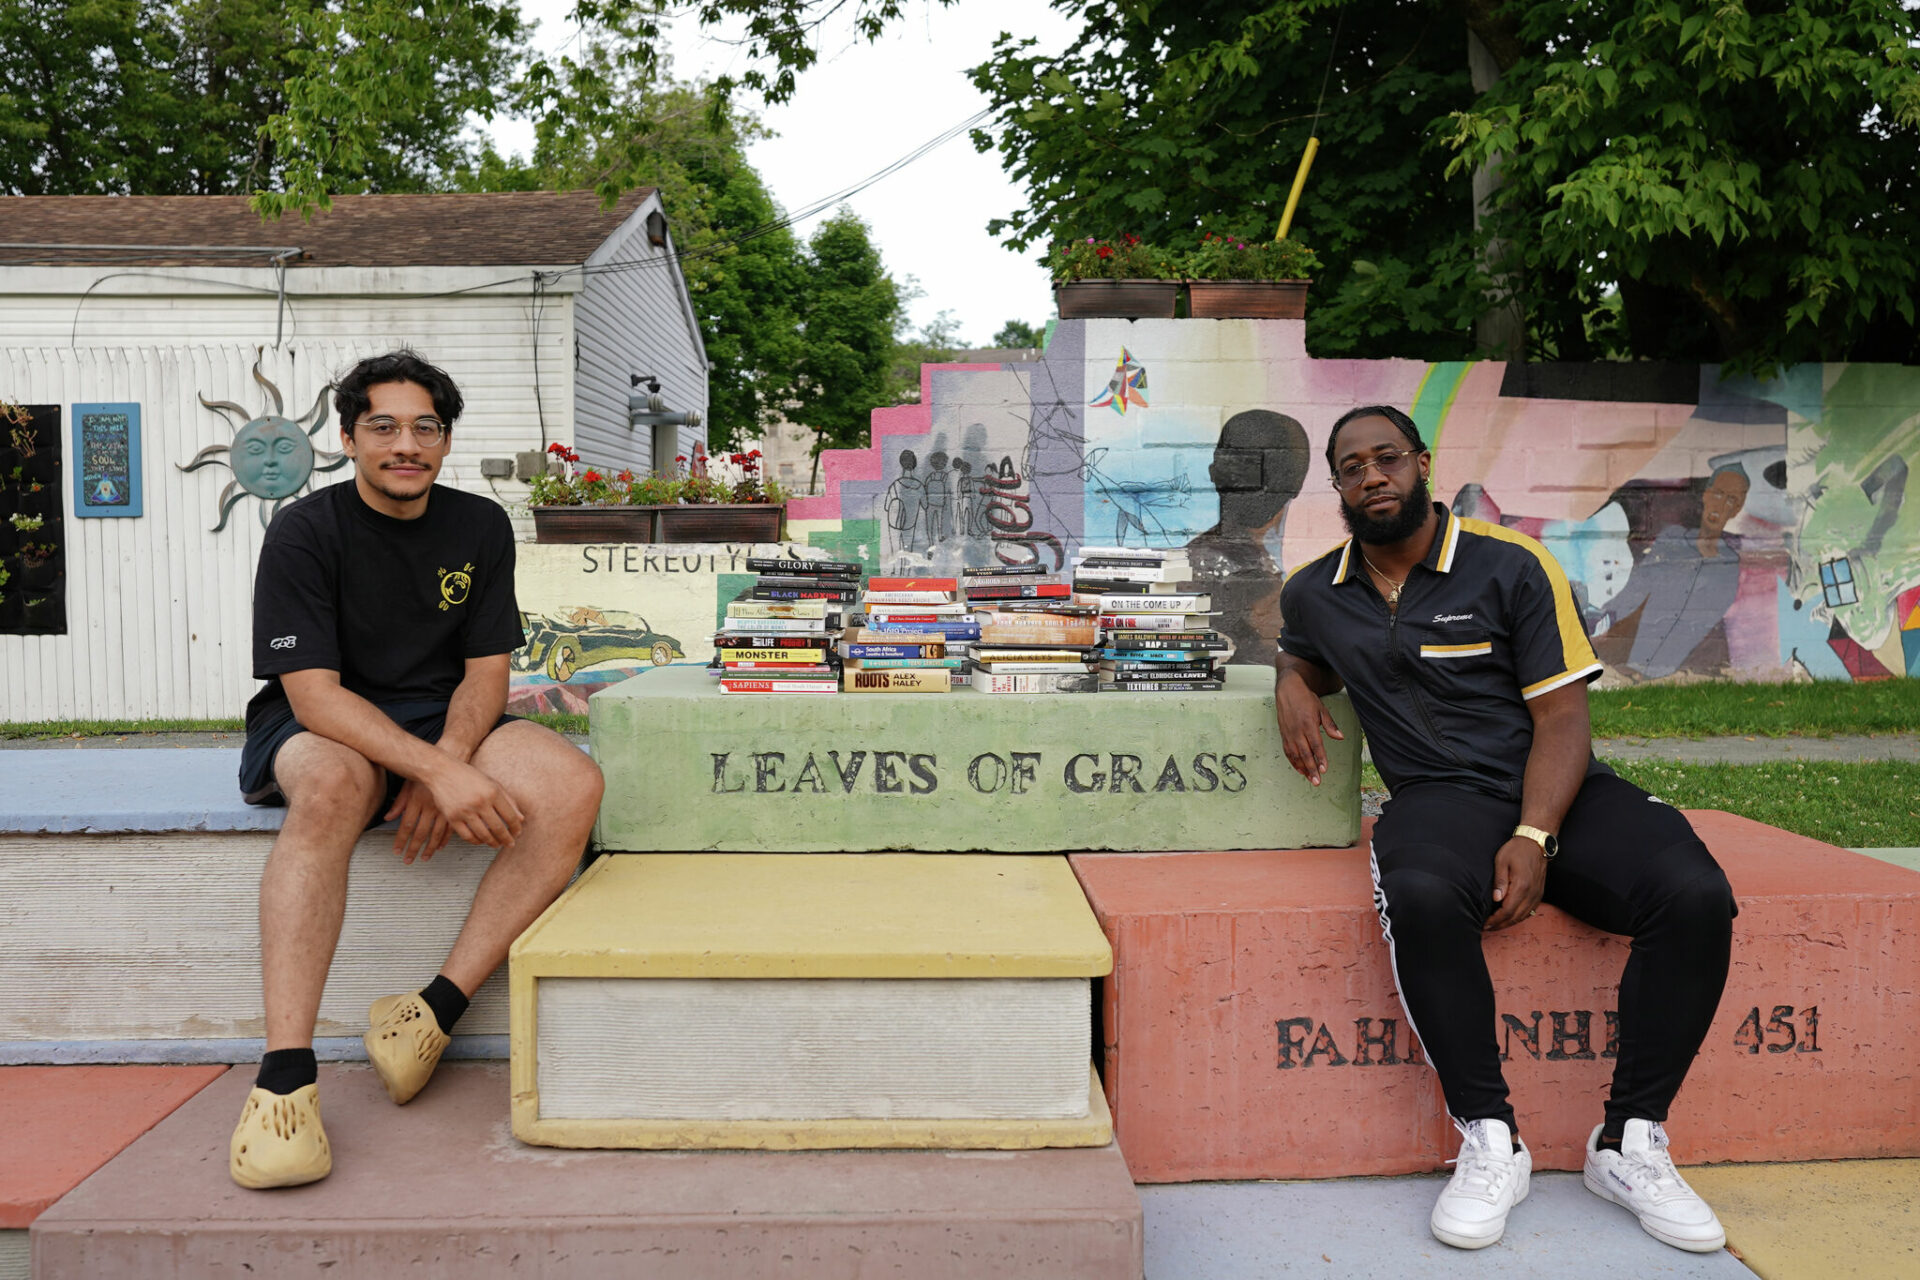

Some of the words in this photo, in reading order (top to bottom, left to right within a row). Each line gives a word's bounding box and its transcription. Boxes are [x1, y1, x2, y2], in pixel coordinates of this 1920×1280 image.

[91, 455, 115, 465] SOUL
[778, 560, 815, 571] GLORY
[771, 590, 799, 598] BLACK
[800, 591, 840, 600] MARXISM
[1111, 600, 1124, 609] ON
[1126, 600, 1141, 609] THE
[1142, 600, 1167, 609] COME
[1170, 600, 1181, 609] UP
[1432, 613, 1474, 624] Supreme
[763, 638, 775, 647] LIFE
[735, 651, 789, 659] MONSTER
[989, 653, 1025, 661] ALICIA
[1028, 653, 1053, 661] KEYS
[732, 681, 770, 689] SAPIENS
[855, 672, 890, 688] ROOTS
[1127, 682, 1159, 691] TEXTURES
[711, 750, 938, 796] LEAVES
[966, 750, 1043, 795] OF
[1063, 750, 1248, 795] GRASS
[1733, 1005, 1823, 1055] 451
